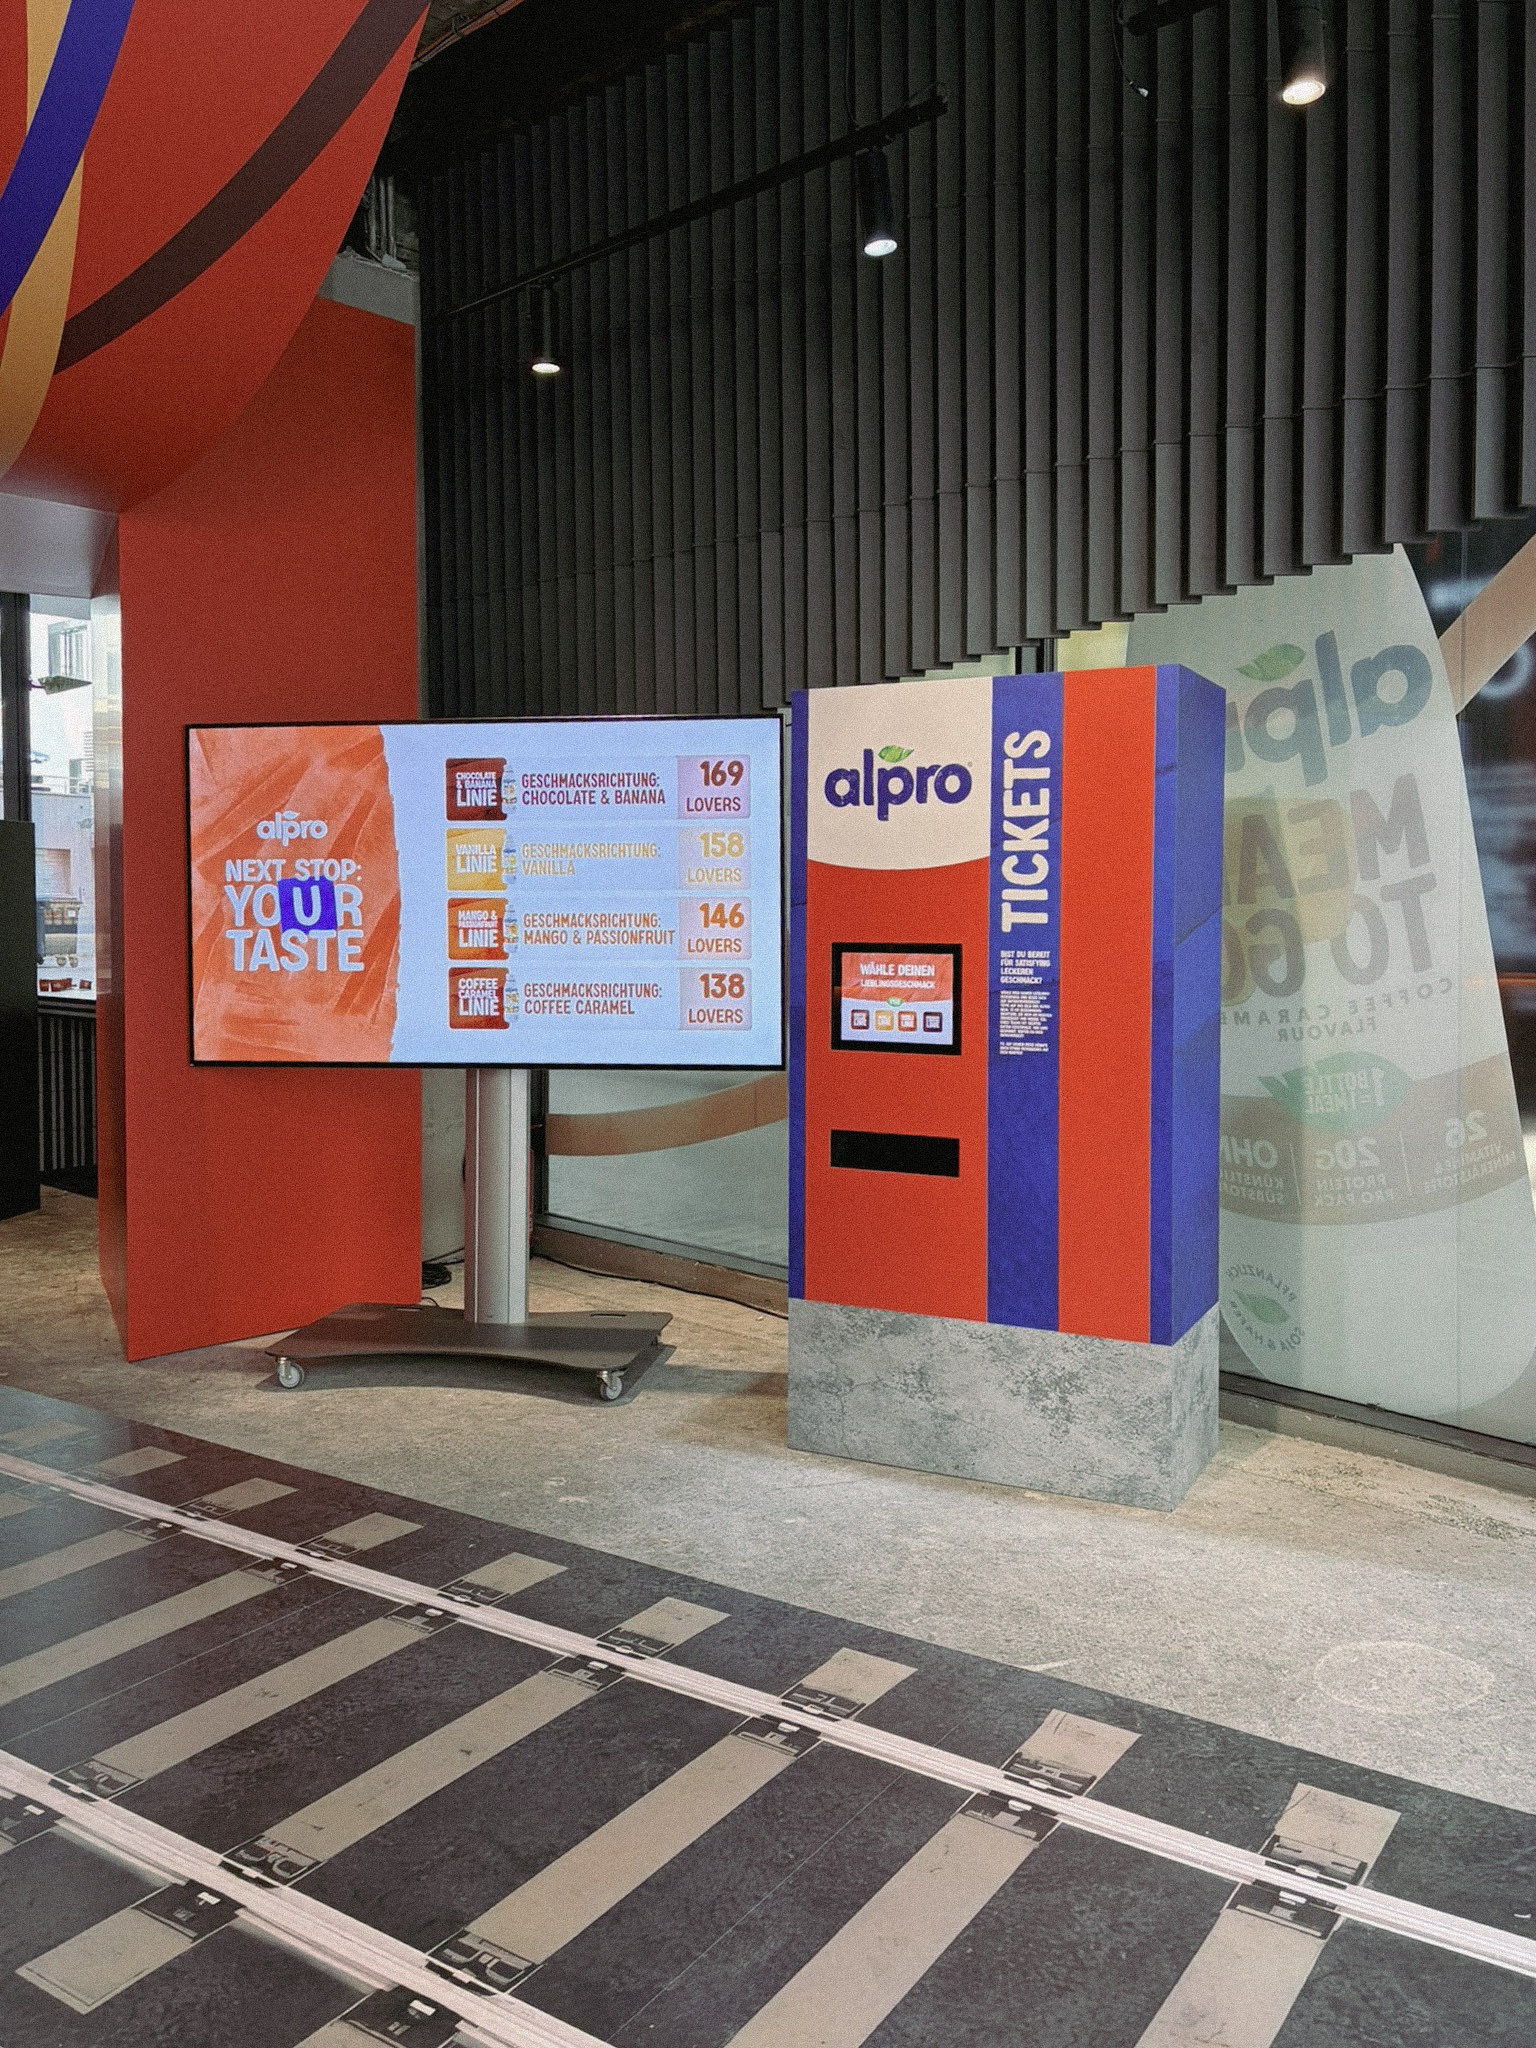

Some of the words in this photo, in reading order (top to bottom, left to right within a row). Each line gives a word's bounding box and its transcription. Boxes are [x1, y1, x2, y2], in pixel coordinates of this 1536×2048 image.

[456, 772, 497, 780] CHOCOLATE
[521, 773, 660, 788] GESCHMACKSRICHTUNG:
[699, 760, 744, 787] 169
[465, 780, 497, 789] BANANA
[824, 749, 973, 822] alpro
[456, 789, 498, 807] LINIE
[522, 789, 596, 805] CHOCOLATE
[601, 789, 609, 805] &
[615, 789, 666, 805] BANANA
[686, 796, 742, 813] LOVERS
[256, 811, 328, 847] alpro
[1001, 729, 1051, 933] TICKETS
[455, 844, 497, 855] VANILLA
[521, 843, 661, 859] GESCHMACKSRICHTUNG:
[699, 832, 744, 859] 158
[225, 859, 286, 882] NEXT
[295, 859, 362, 882] STOP:
[456, 855, 498, 874] LINIE
[521, 860, 576, 876] VANILLA
[687, 868, 742, 884] LOVERS
[224, 885, 363, 927] YOUR
[458, 910, 489, 921] MANGO
[491, 910, 498, 921] &
[523, 913, 661, 928] GESCHMACKSRICHTUNG:
[699, 903, 745, 929] 146
[459, 929, 499, 948] LINIE
[523, 930, 568, 945] MANGO
[573, 930, 581, 945] &
[586, 930, 676, 945] PASSIONFRUIT
[687, 938, 742, 953] LOVERS
[226, 929, 365, 972] TASTE
[1016, 950, 1026, 958] DU
[860, 962, 895, 976] WÄHLE
[897, 964, 935, 977] DEINEN
[458, 978, 498, 989] COFFEE
[523, 983, 662, 998] GESCHMACKSRICHTUNG:
[699, 973, 745, 999] 138
[458, 989, 498, 999] CARAMEL
[458, 999, 500, 1016] LINIE
[524, 999, 571, 1015] COFFEE
[575, 999, 635, 1015] CARAMEL
[688, 1008, 743, 1024] LOVERS
